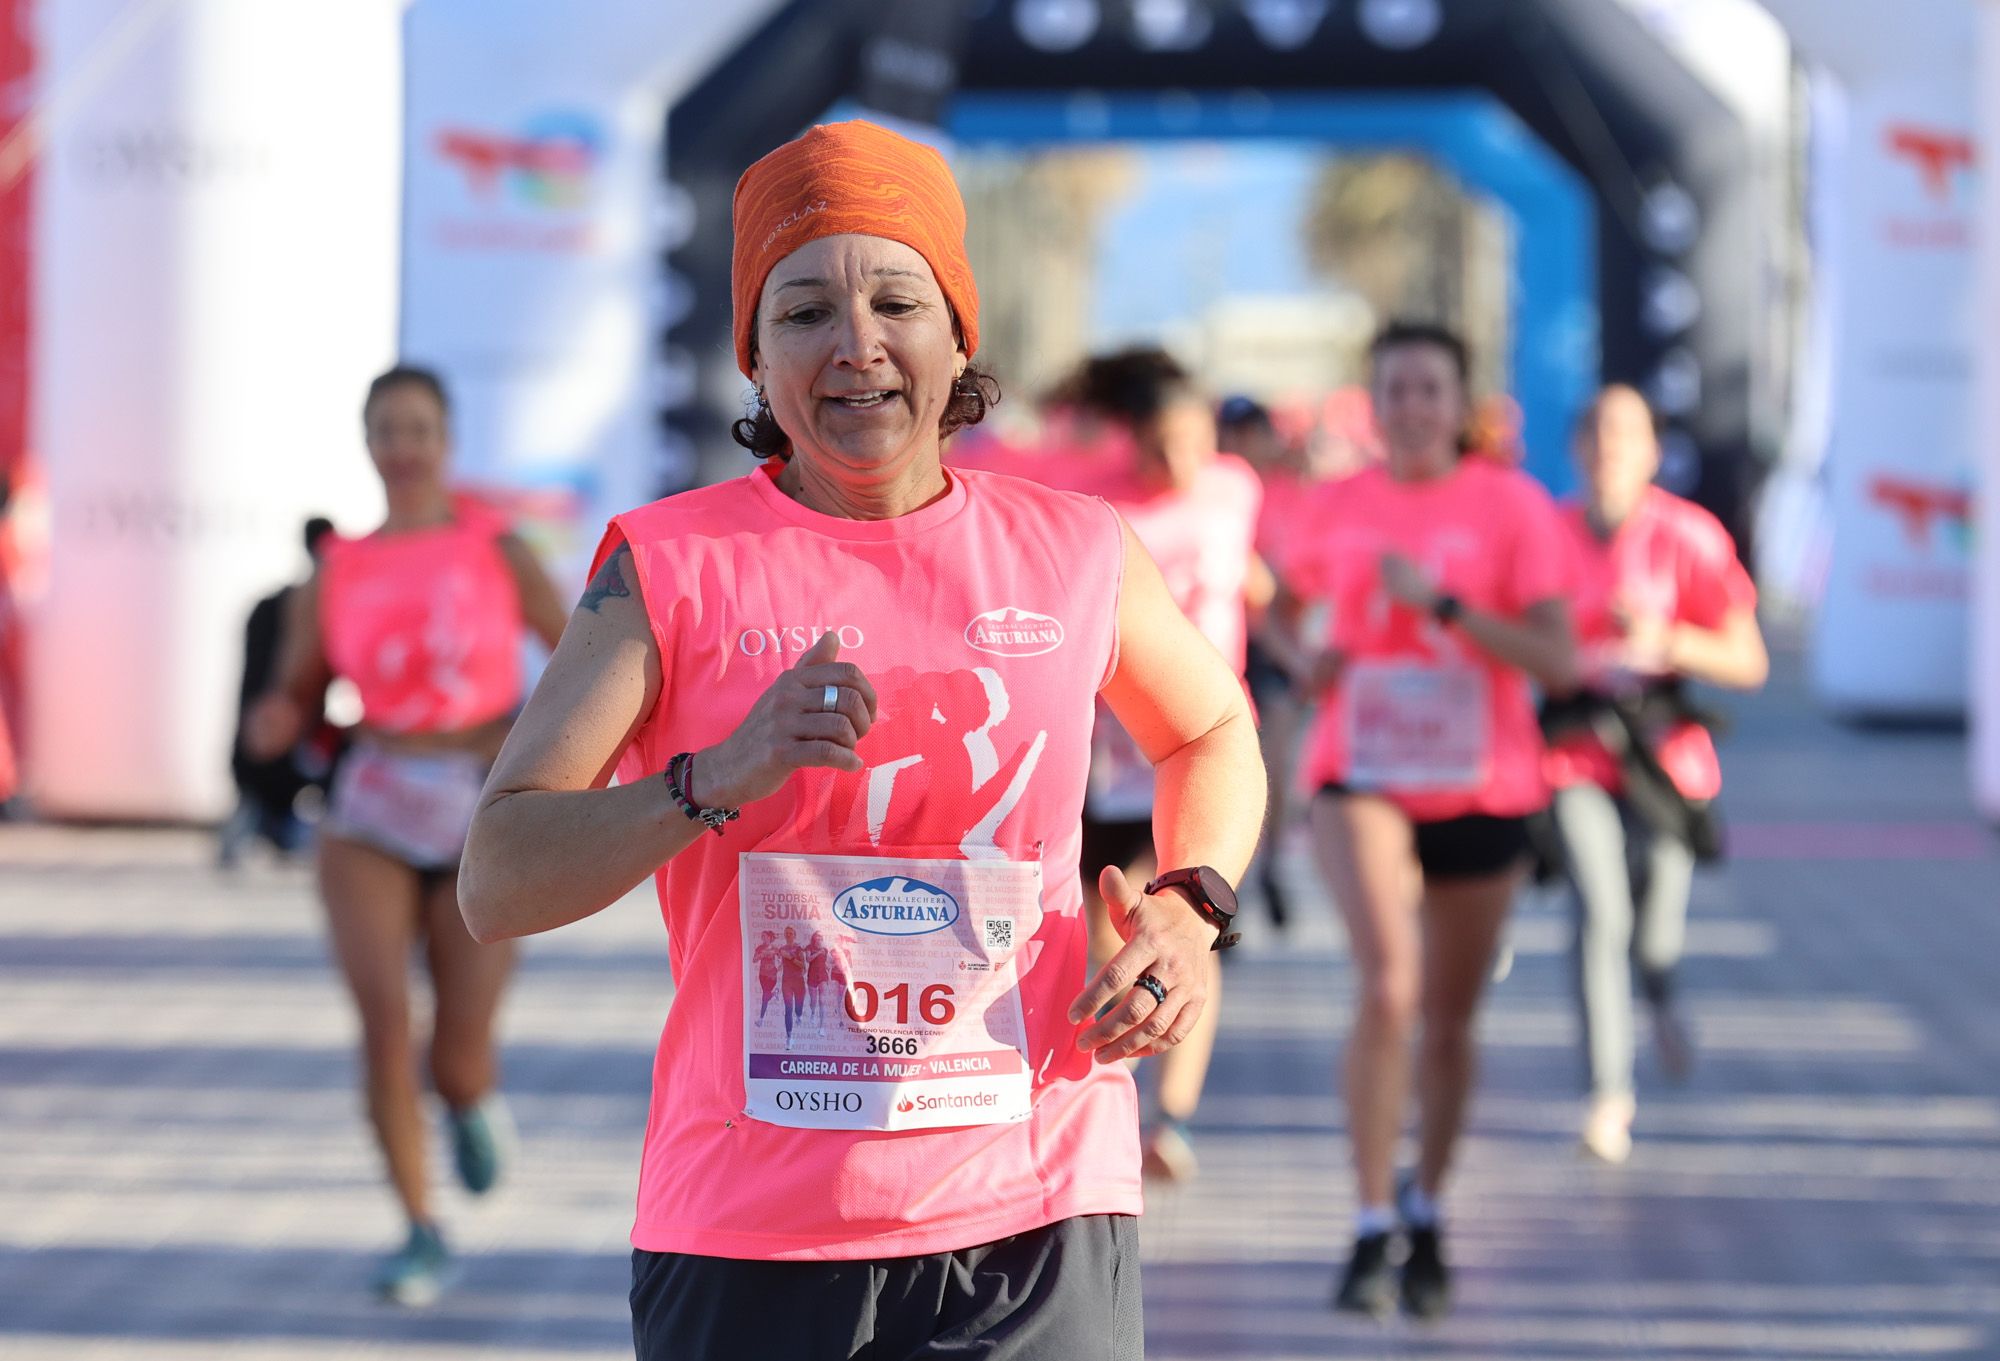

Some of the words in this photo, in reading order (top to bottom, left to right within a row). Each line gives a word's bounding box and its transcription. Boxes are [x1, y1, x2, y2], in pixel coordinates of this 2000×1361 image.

[974, 624, 1058, 645] ASTURIANA
[761, 893, 776, 903] TU
[780, 893, 820, 904] DORSAL
[842, 896, 950, 921] ASTURIANA
[862, 895, 903, 903] CENTRAL
[764, 904, 821, 920] SUMA
[845, 981, 955, 1025] 016
[879, 1028, 913, 1036] VIOLENCIA
[866, 1035, 917, 1055] 3666
[780, 1060, 837, 1075] CARRERA
[842, 1062, 859, 1076] DE
[863, 1063, 879, 1077] LA
[929, 1057, 991, 1074] VALENCIA
[776, 1091, 862, 1112] OYSHO
[916, 1091, 998, 1110] Santander
